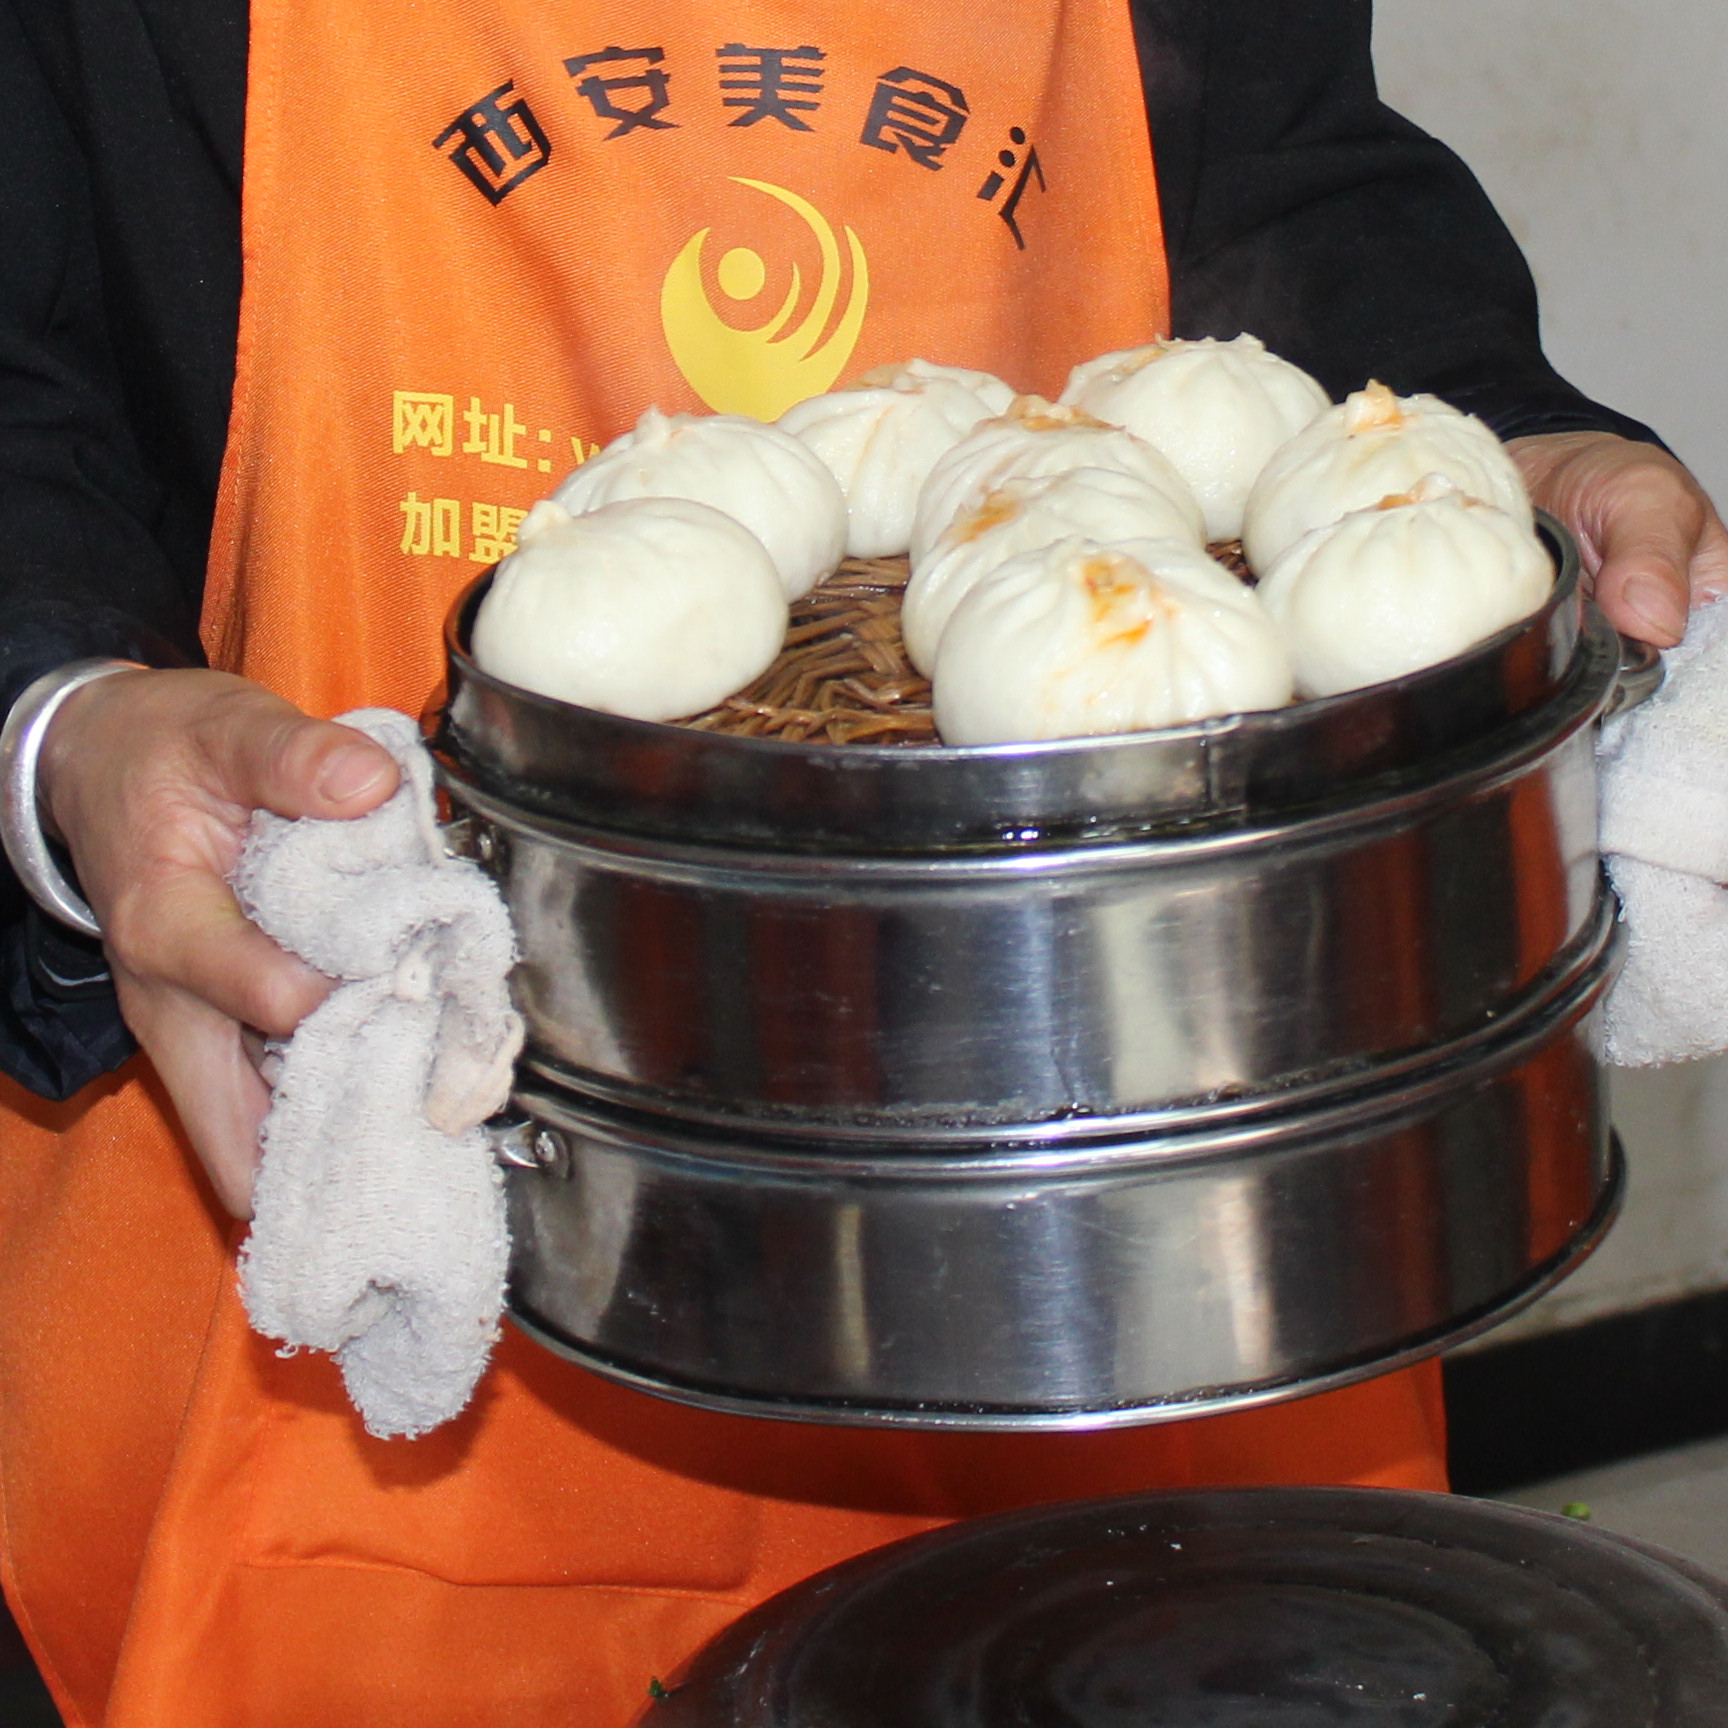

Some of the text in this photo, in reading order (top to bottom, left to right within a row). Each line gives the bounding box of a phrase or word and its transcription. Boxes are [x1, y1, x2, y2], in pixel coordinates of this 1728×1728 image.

[431, 42, 1047, 251] 西安美食汇
[399, 491, 529, 565] 加盟
